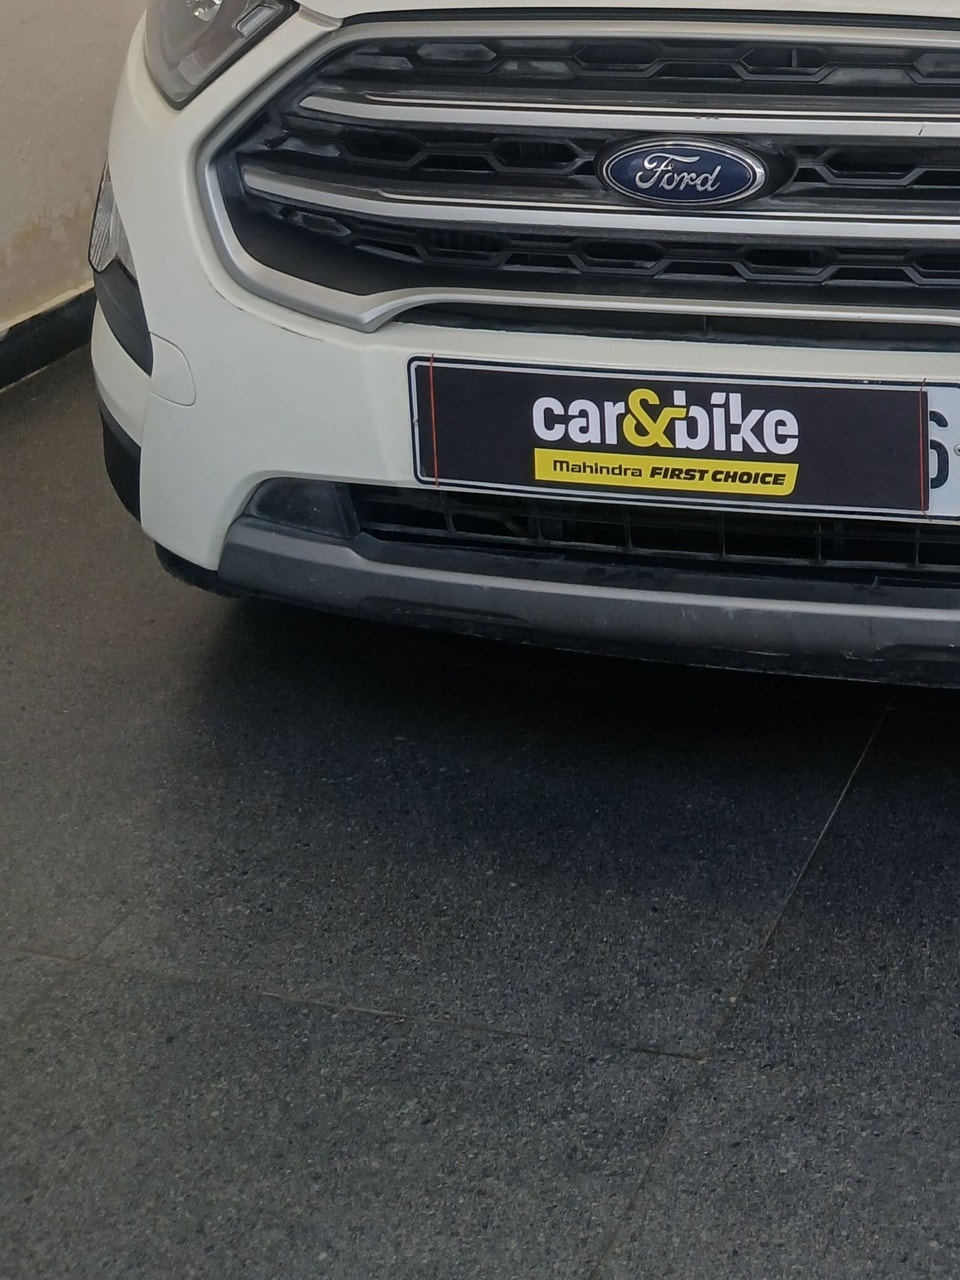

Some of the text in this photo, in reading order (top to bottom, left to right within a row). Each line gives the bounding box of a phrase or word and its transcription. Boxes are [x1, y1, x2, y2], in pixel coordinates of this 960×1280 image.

[635, 152, 722, 192] Ford
[532, 388, 800, 456] car&bike
[552, 459, 787, 486] Mahindra FIRST CHOICE
